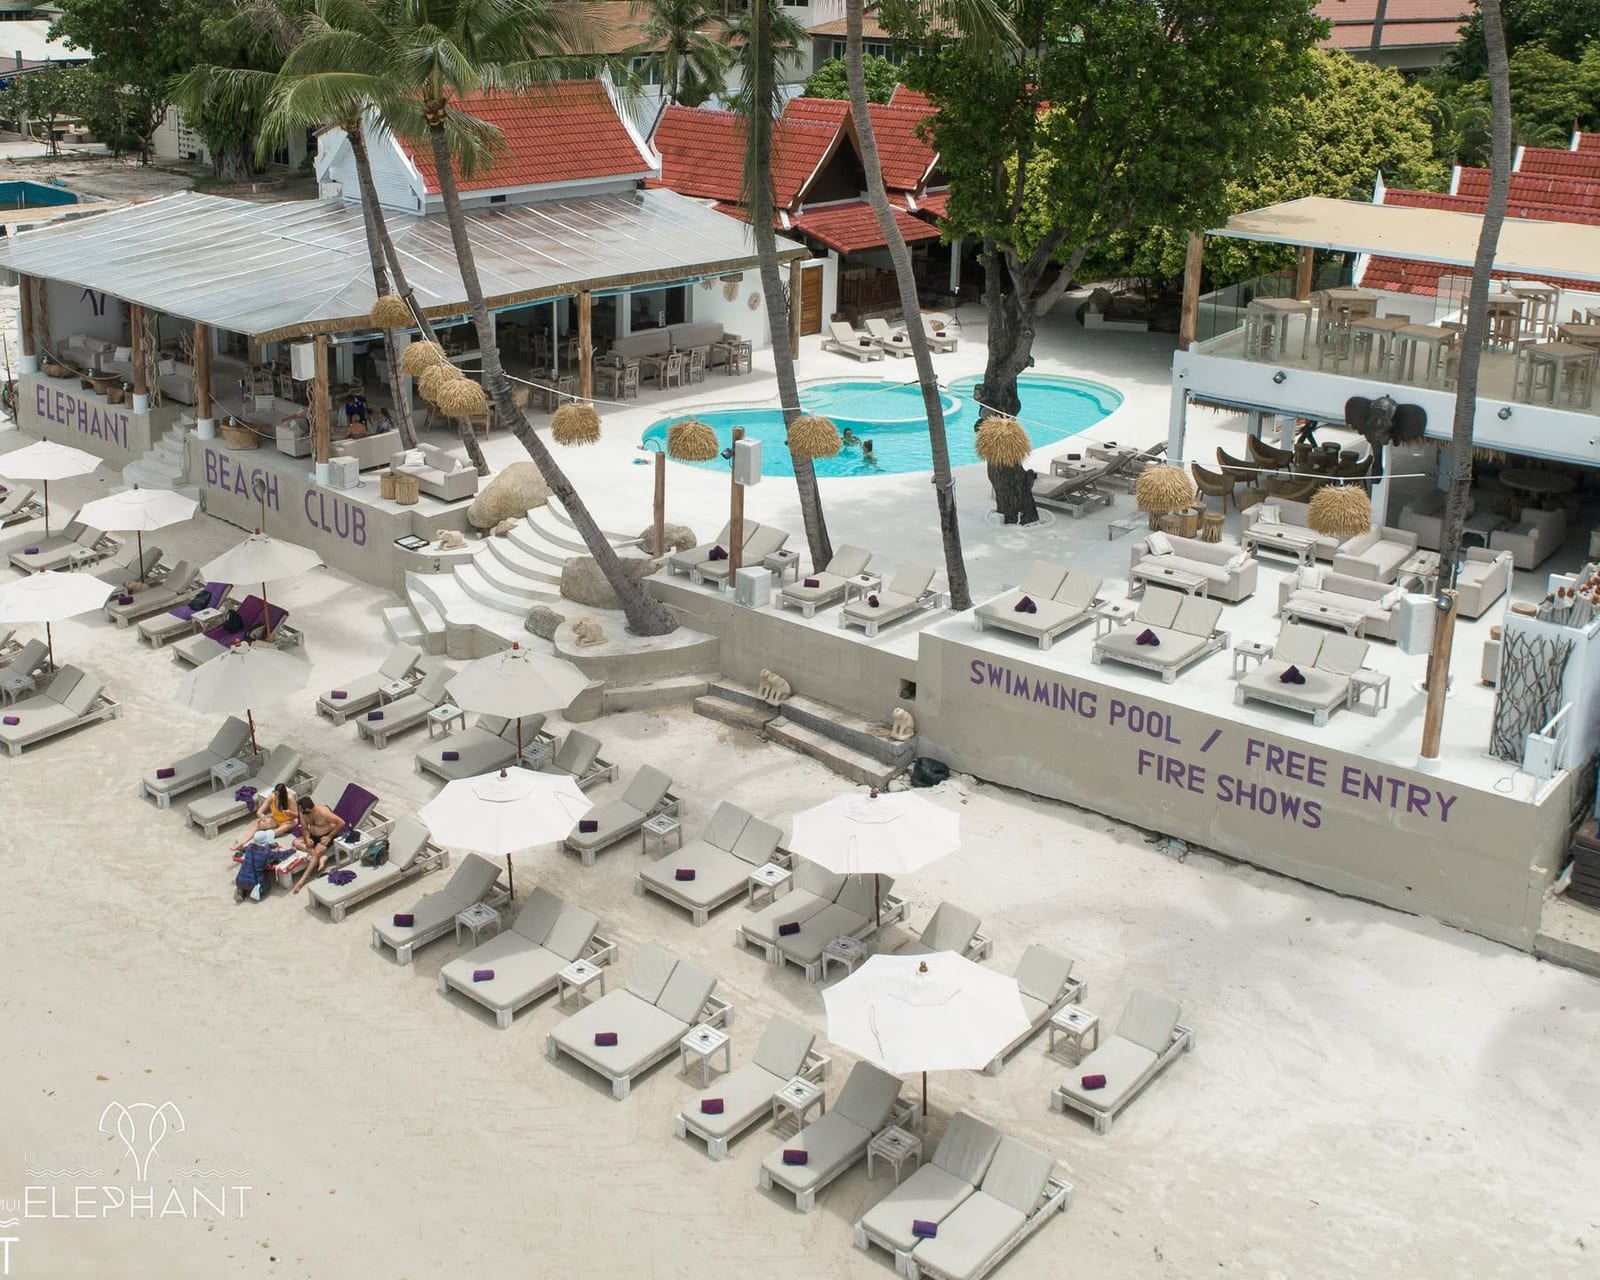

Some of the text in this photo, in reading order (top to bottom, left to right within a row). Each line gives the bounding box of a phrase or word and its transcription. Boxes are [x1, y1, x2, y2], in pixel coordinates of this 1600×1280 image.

[36, 384, 129, 448] ELEPHANT
[205, 448, 367, 547] BEACH CLUB
[970, 659, 1459, 823] SWIMMING POOL / FREE ENTRY
[1138, 749, 1323, 829] FIRE SHOWS
